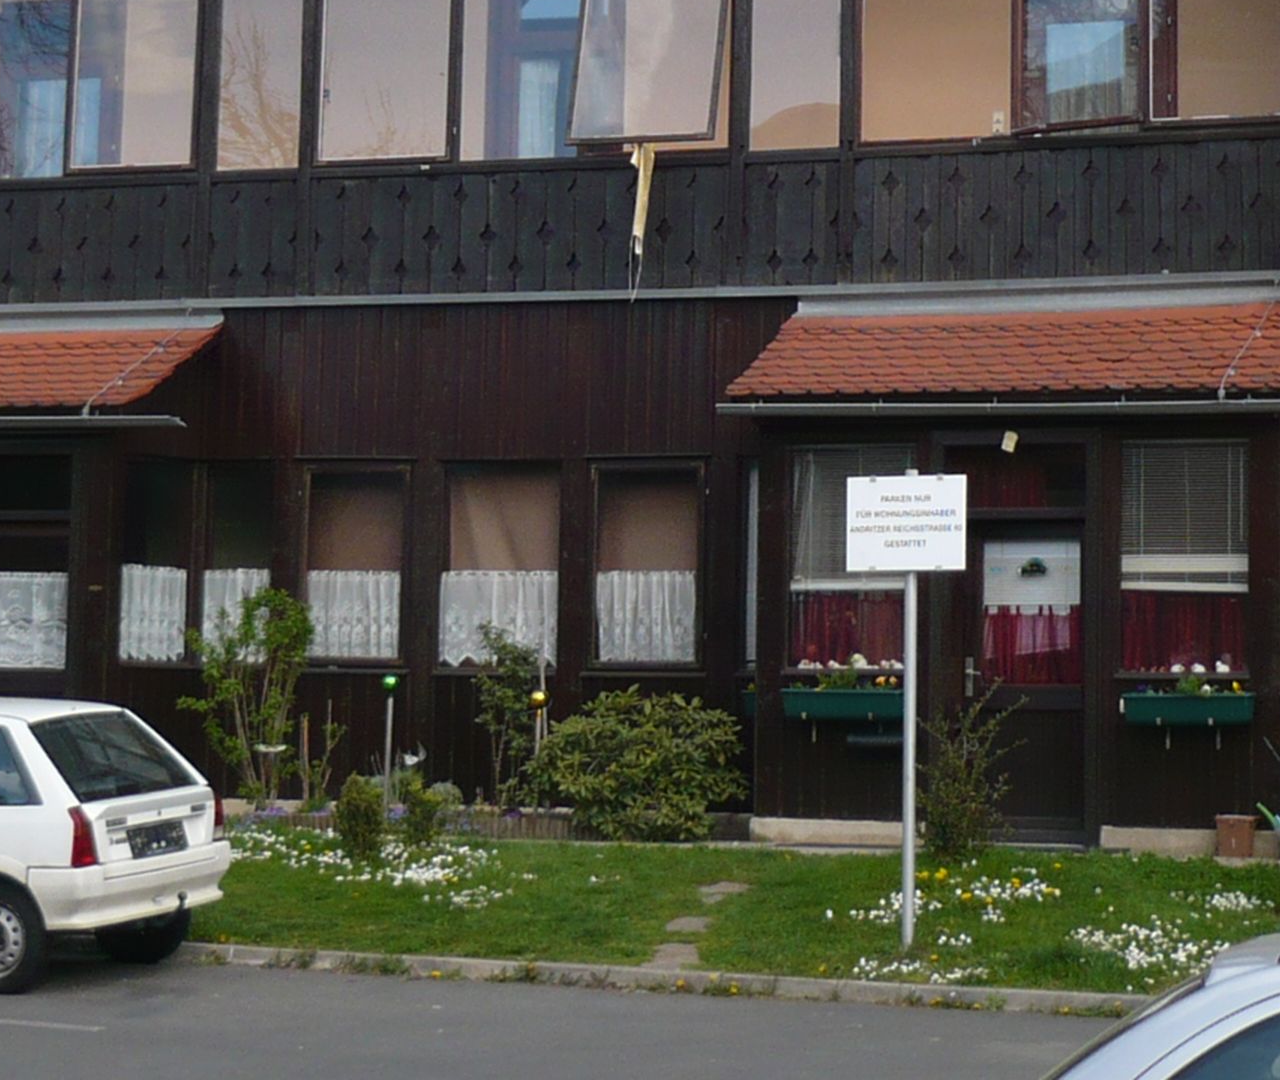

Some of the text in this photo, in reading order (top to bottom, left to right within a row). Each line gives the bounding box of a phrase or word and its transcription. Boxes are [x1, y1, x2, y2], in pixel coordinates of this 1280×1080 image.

[914, 494, 931, 502] NUR
[856, 510, 872, 519] FÜR
[850, 525, 891, 533] ANDRITZER
[884, 539, 926, 547] GESTATTET
